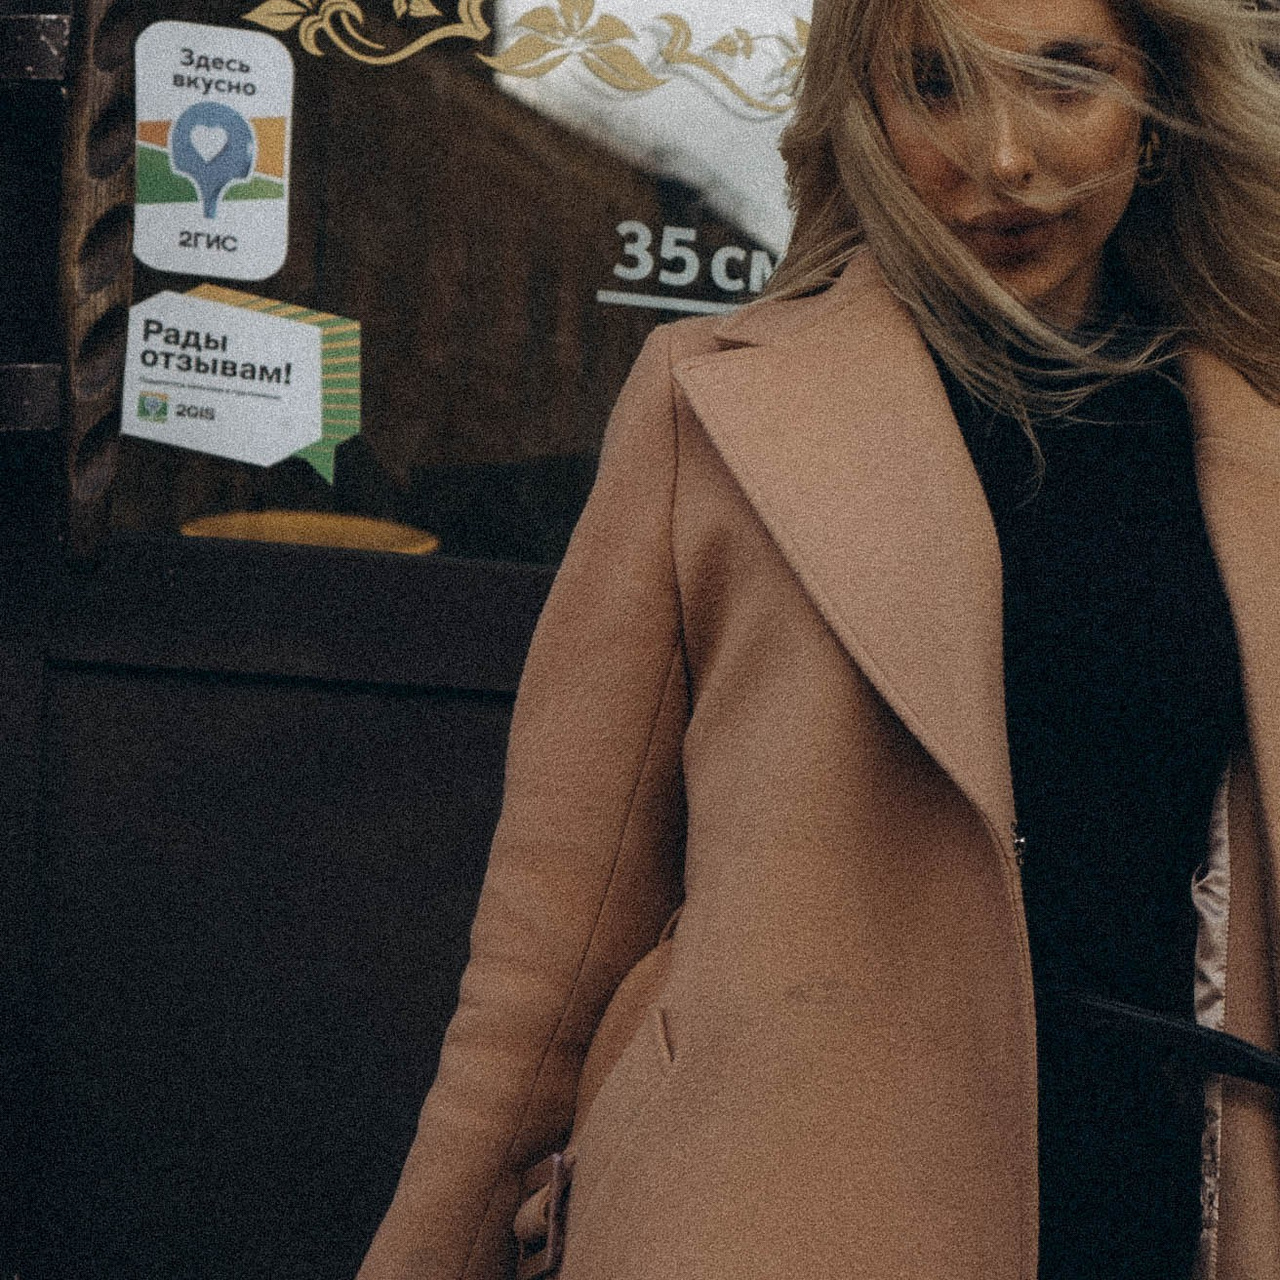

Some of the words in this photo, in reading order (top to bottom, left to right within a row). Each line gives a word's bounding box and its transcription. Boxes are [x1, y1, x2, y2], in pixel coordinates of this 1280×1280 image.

[180, 48, 250, 73] Здесь
[172, 74, 256, 96] вкусно
[178, 230, 238, 252] 2ГИС
[143, 319, 228, 352] Рады
[140, 349, 292, 385] отзывам!
